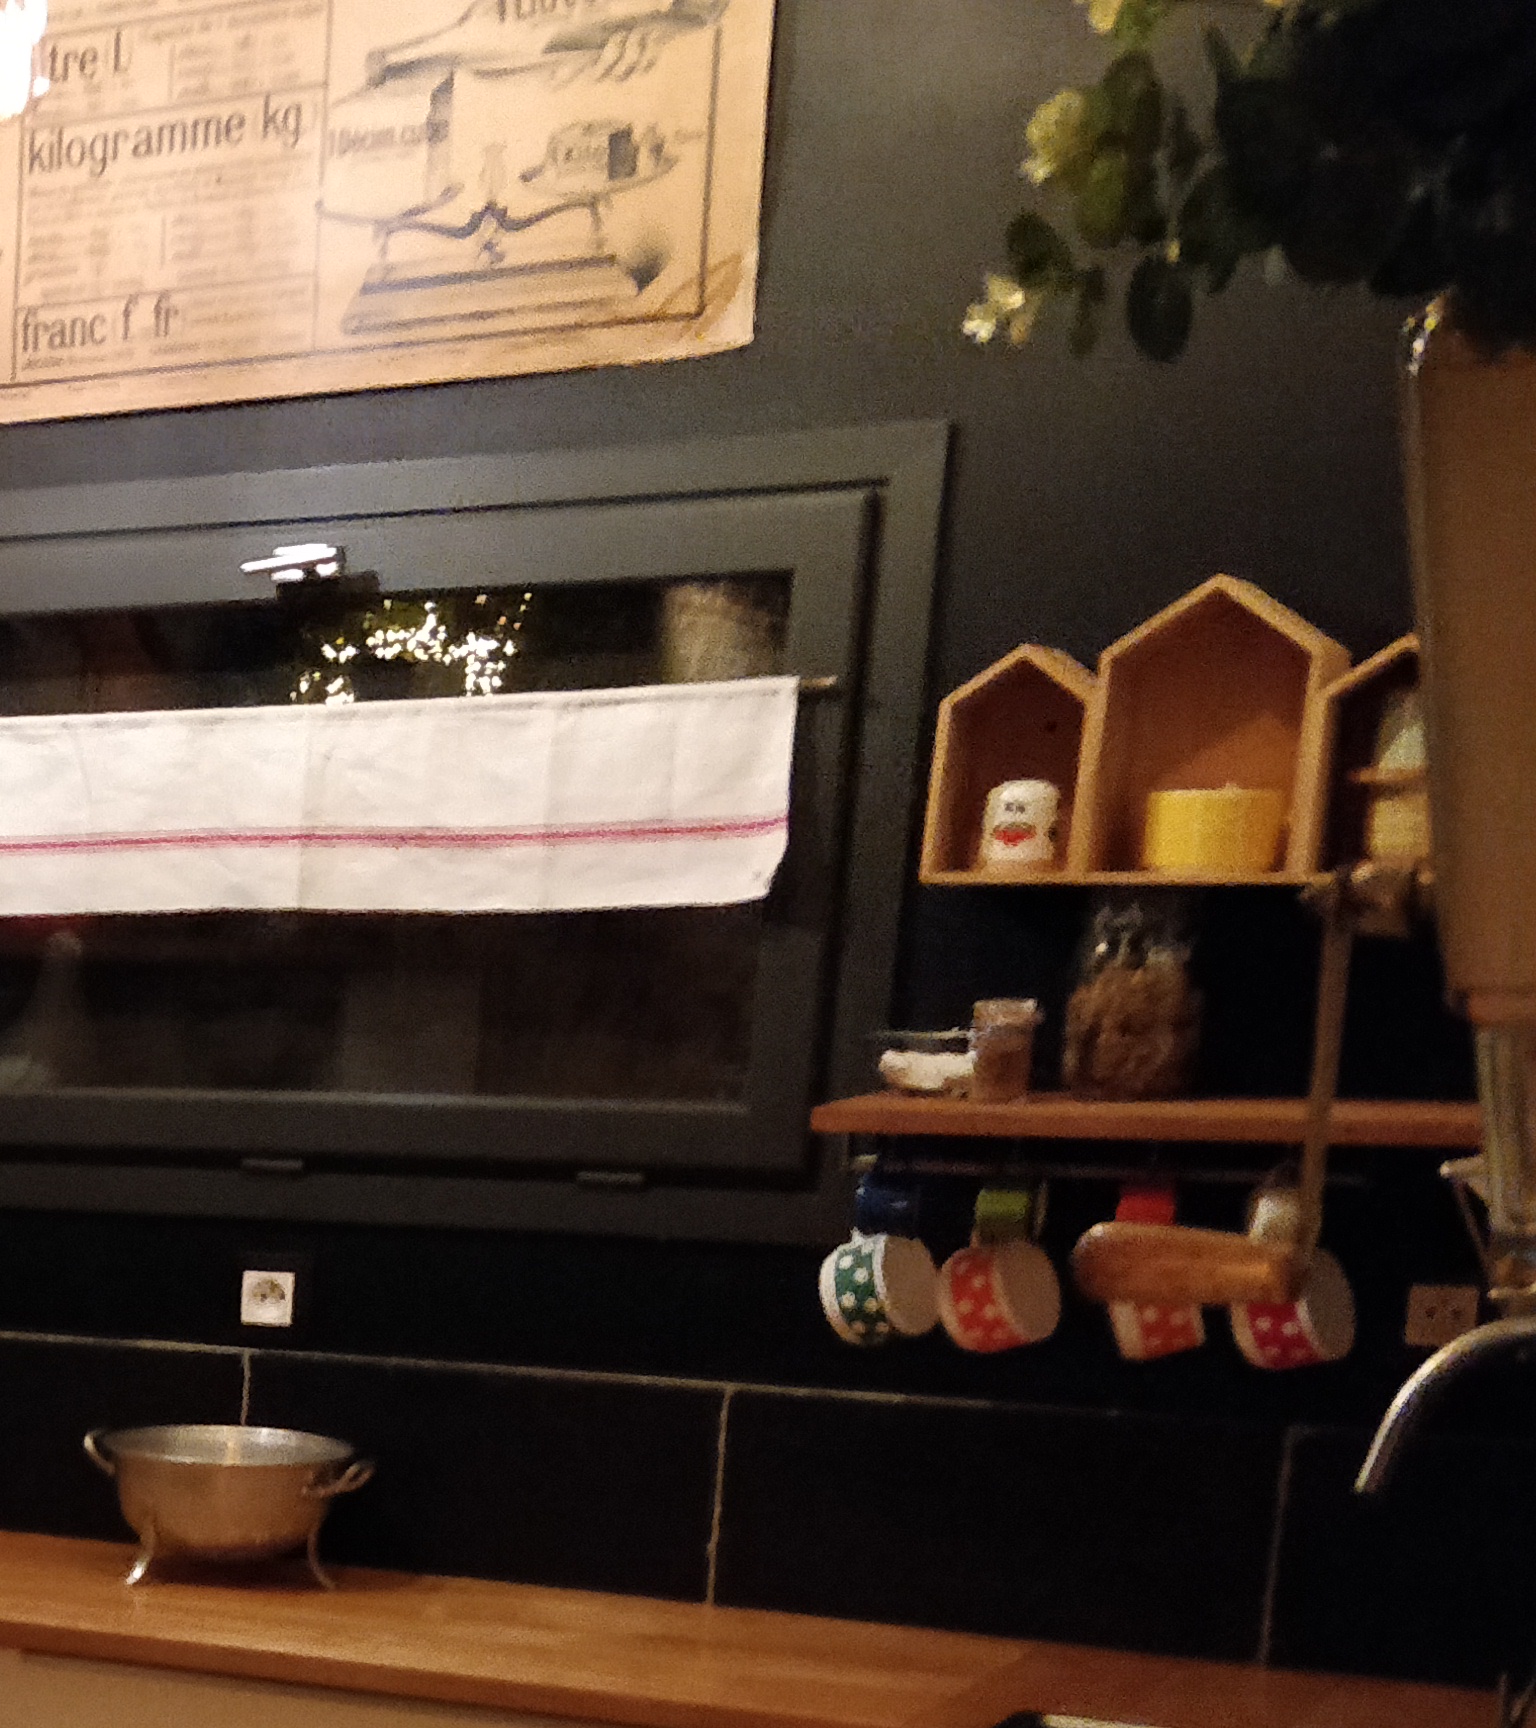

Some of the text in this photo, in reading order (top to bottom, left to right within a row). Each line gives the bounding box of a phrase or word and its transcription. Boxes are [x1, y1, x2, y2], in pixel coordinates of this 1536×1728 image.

[28, 93, 303, 178] kilogramme kg
[21, 303, 107, 353] franc
